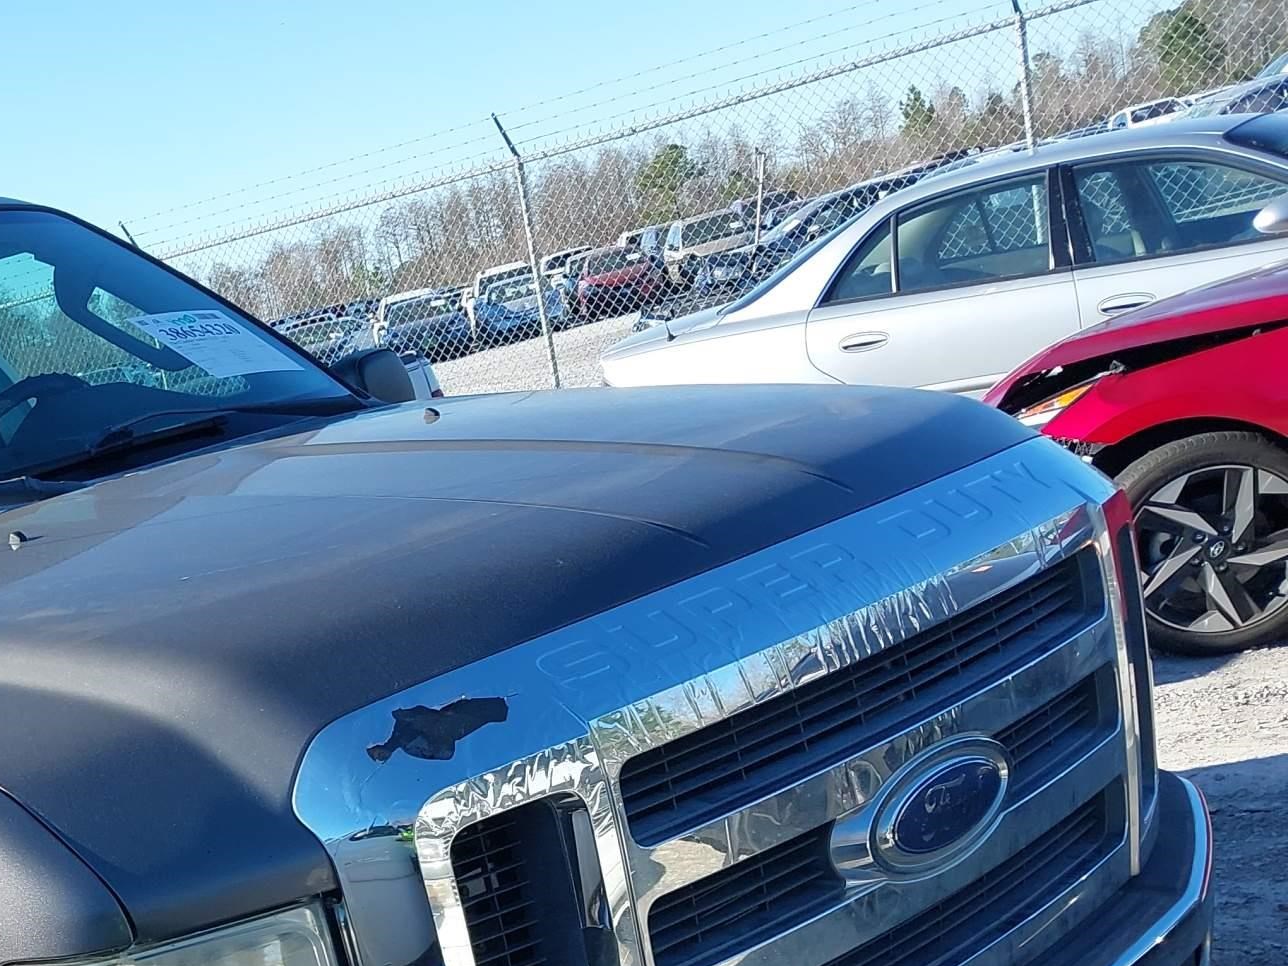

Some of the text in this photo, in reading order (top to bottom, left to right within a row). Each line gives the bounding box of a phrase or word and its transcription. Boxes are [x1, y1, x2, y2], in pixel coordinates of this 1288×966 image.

[158, 322, 241, 341] 38654320
[535, 460, 1054, 684] SUPER DUTY
